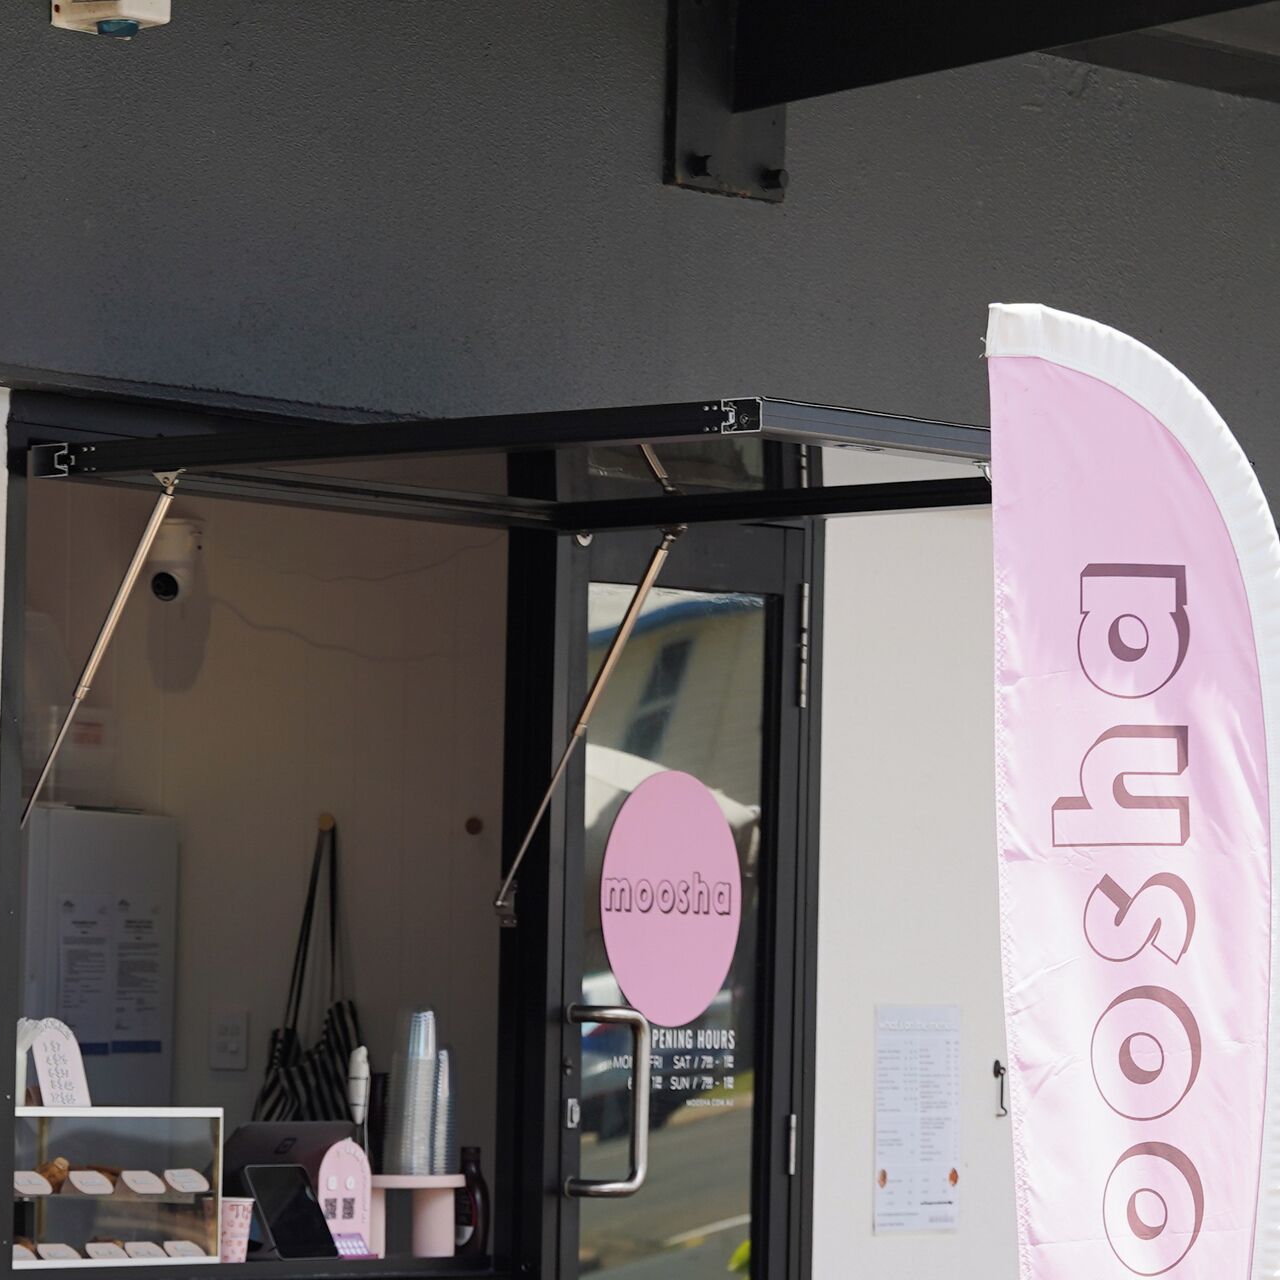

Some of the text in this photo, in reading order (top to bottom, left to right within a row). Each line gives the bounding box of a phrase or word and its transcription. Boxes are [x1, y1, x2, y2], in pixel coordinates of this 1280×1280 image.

[604, 872, 732, 915] moosha
[651, 1029, 736, 1050] PENING HOURS
[673, 1055, 692, 1069] SAT
[670, 1076, 690, 1090] SUN
